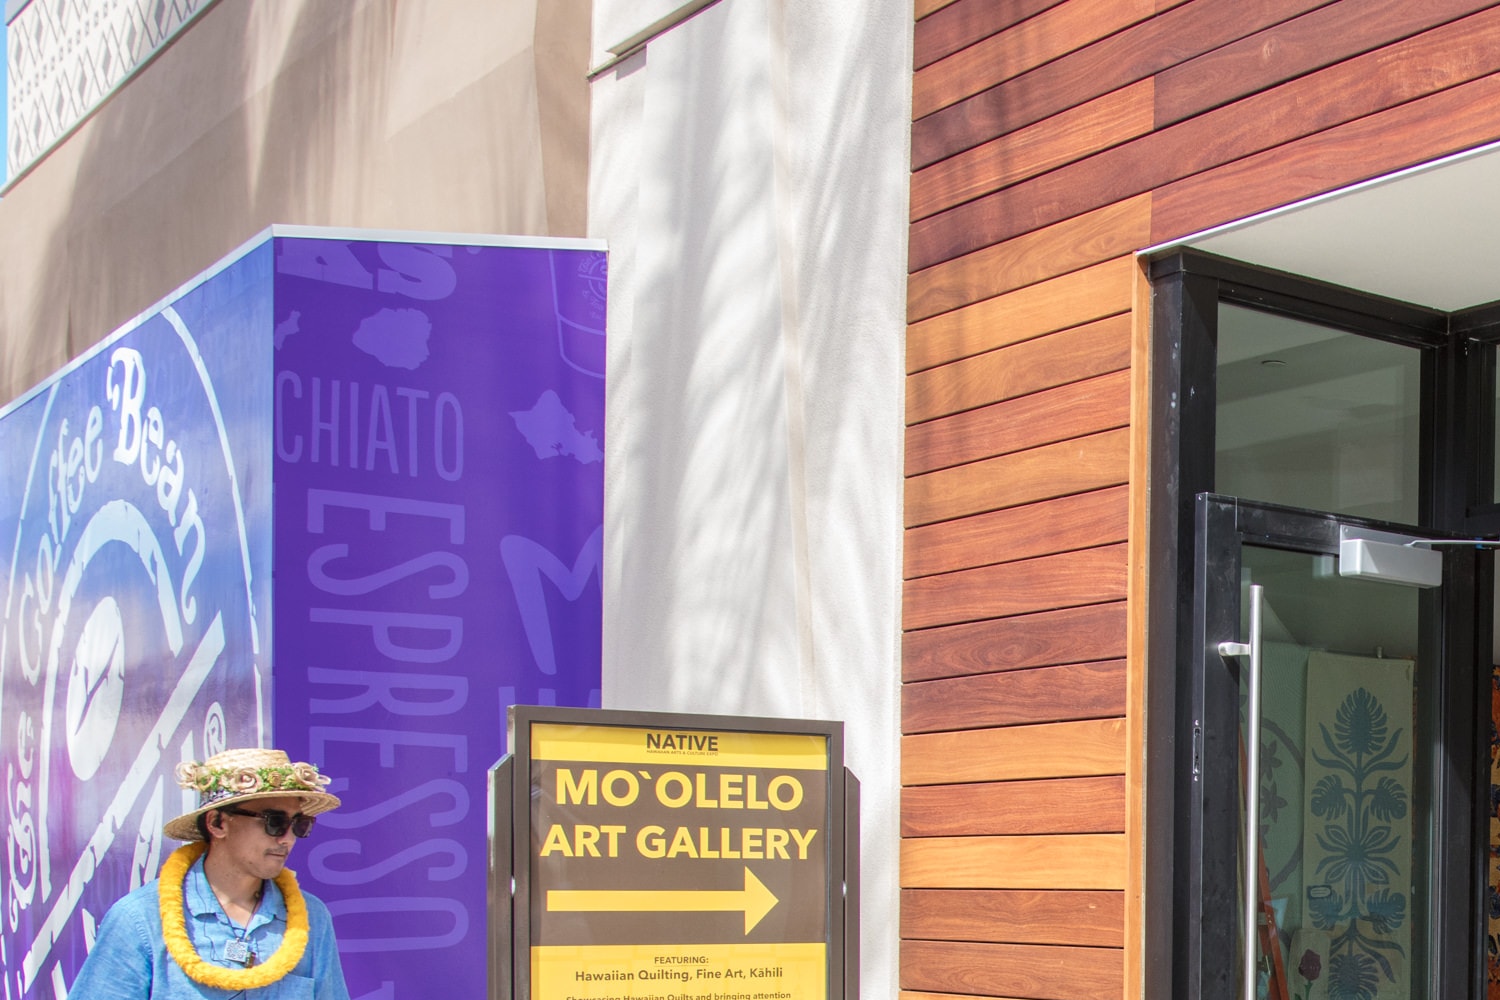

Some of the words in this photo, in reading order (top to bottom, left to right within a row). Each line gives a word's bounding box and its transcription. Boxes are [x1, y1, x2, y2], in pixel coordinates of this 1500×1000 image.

[277, 371, 463, 481] CHIATO
[19, 405, 102, 686] Coffee
[106, 347, 206, 625] Bean
[307, 488, 471, 954] ESPRESSO
[646, 733, 719, 752] NATIVE
[540, 824, 627, 858] ART
[636, 825, 818, 860] GALLERY
[654, 956, 709, 965] FEATURING:
[575, 971, 634, 982] Hawaiian
[638, 969, 693, 982] Quilting,
[696, 968, 722, 979] Fine
[725, 968, 746, 980] Art,
[695, 993, 712, 1000] and
[753, 991, 791, 1000] attention
